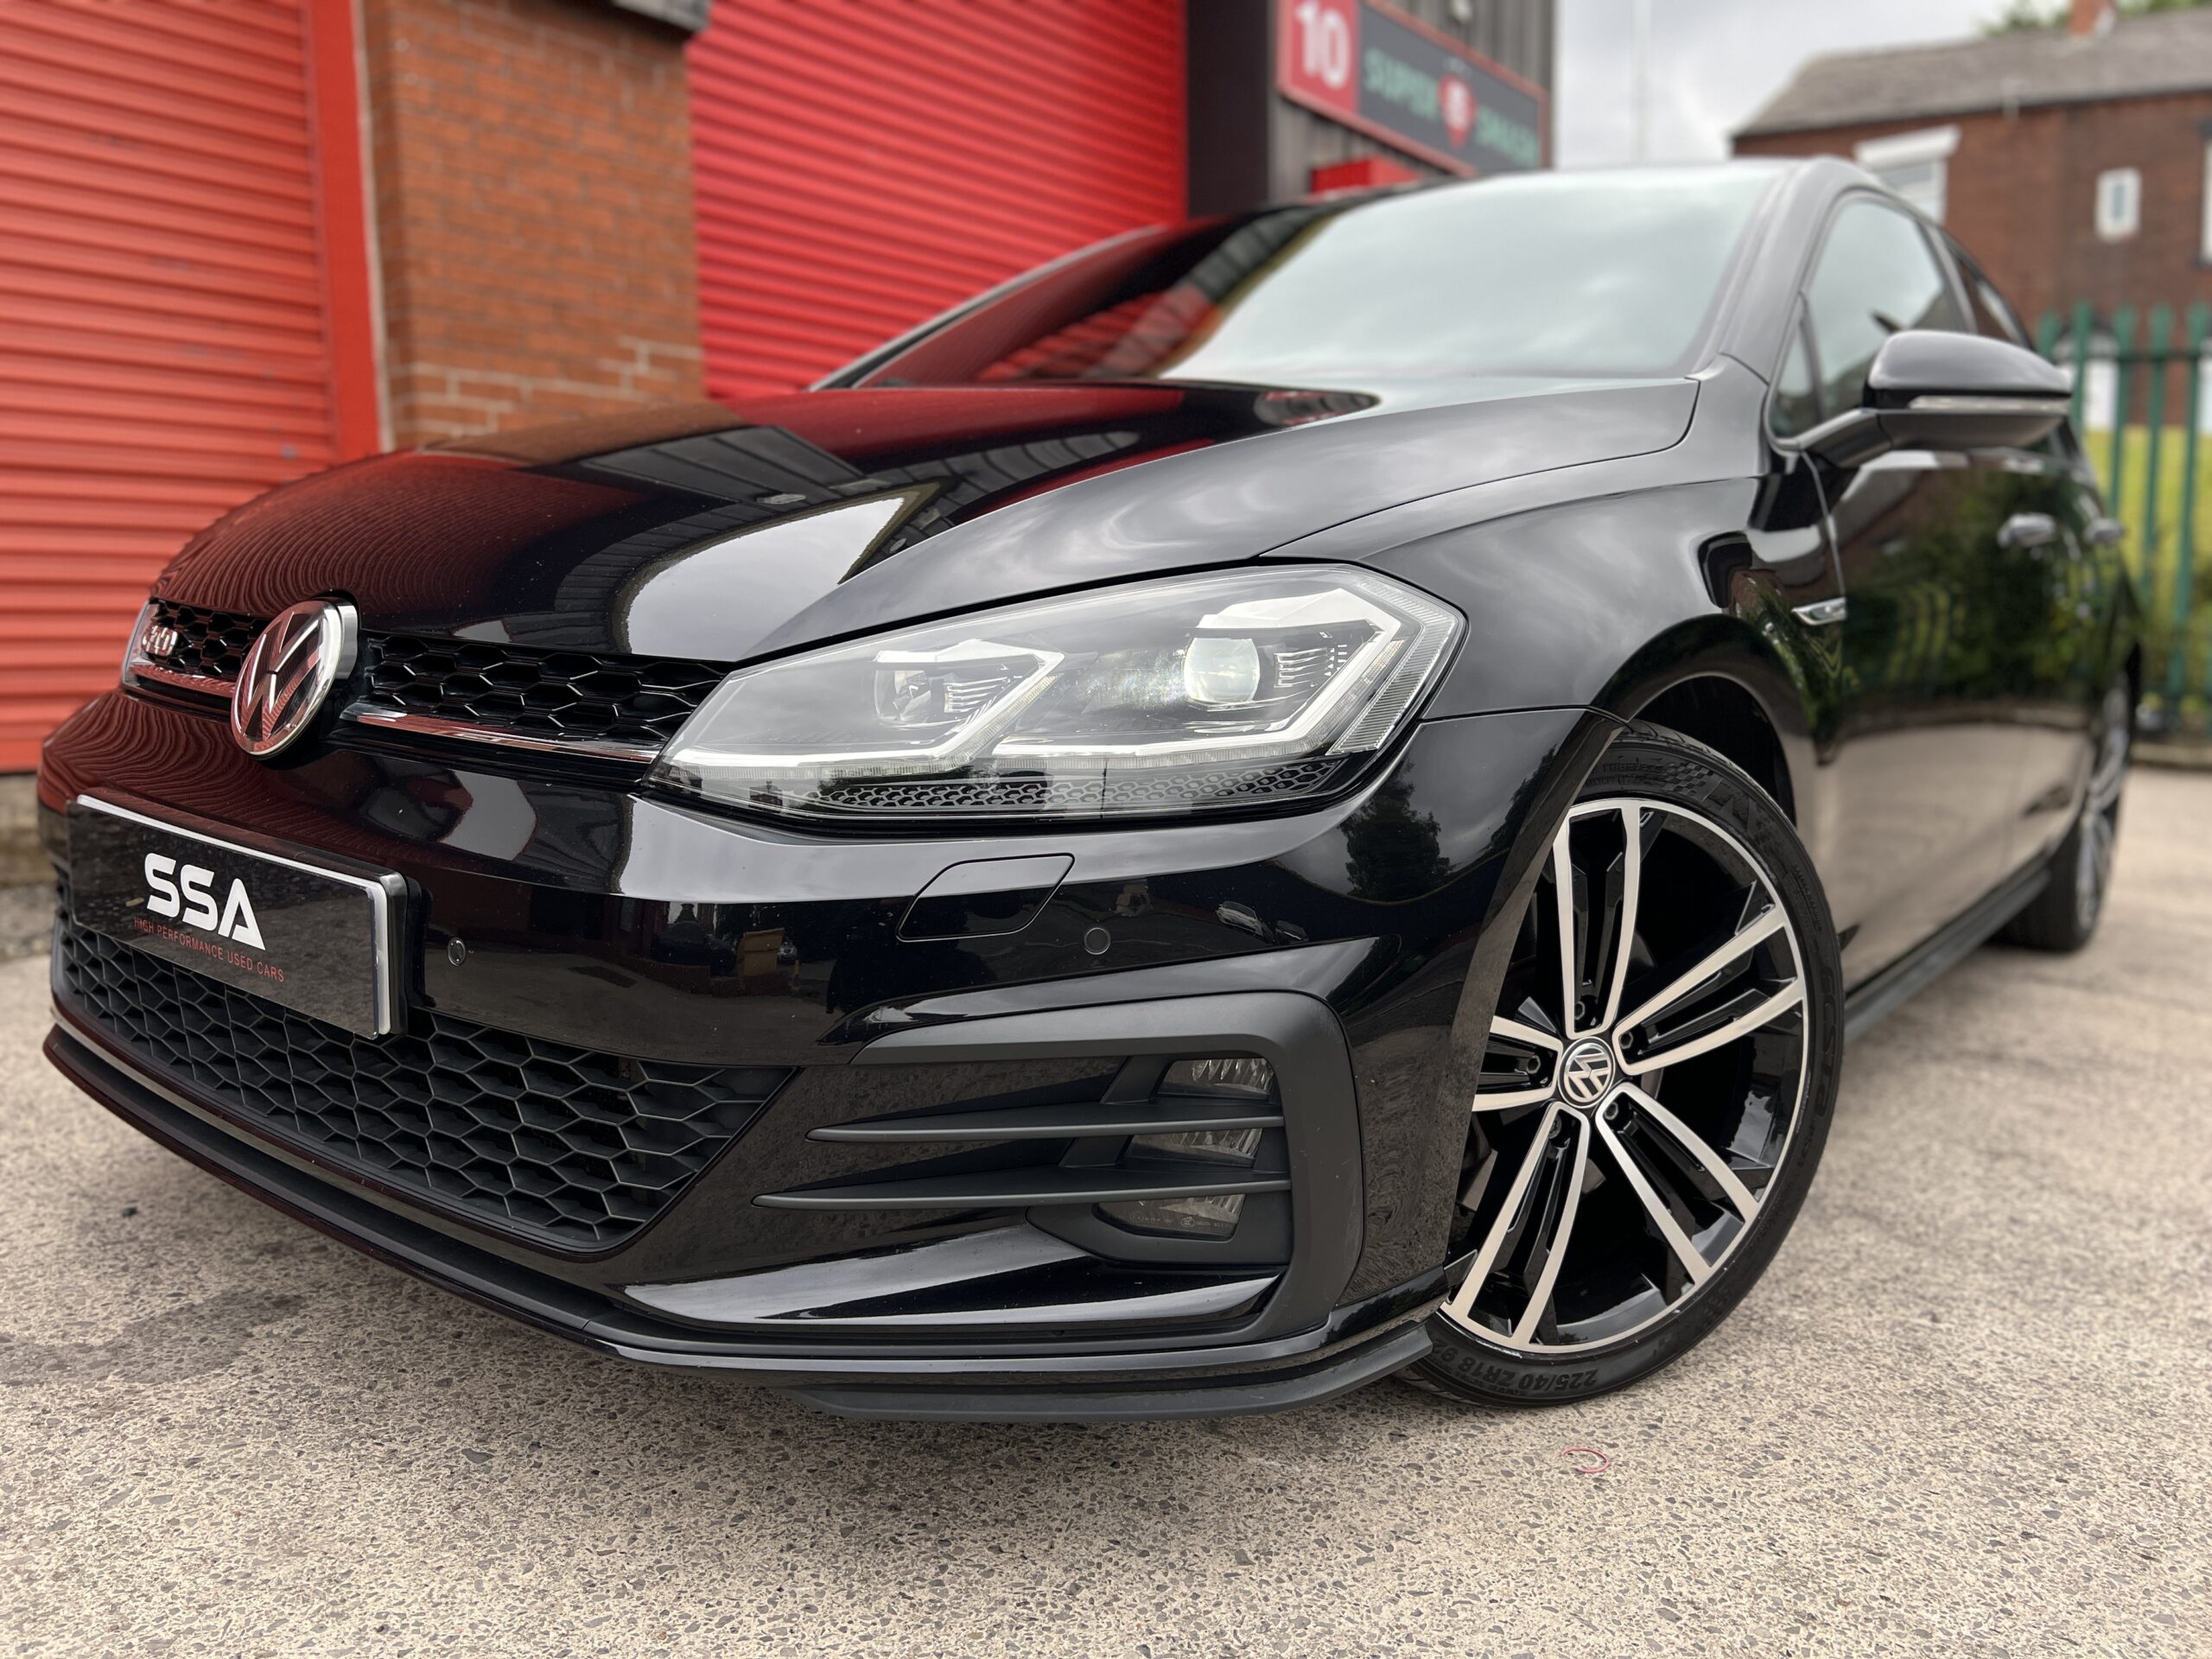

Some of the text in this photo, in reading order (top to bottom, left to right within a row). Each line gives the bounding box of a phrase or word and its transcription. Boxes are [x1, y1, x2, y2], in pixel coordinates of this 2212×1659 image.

[1294, 1, 1351, 90] 10
[144, 852, 266, 950] SSA
[134, 916, 284, 982] HIGH PERFORMANCE USED CARS
[1458, 1356, 1516, 1387] ZR18
[1517, 1369, 1599, 1391] 225/40
